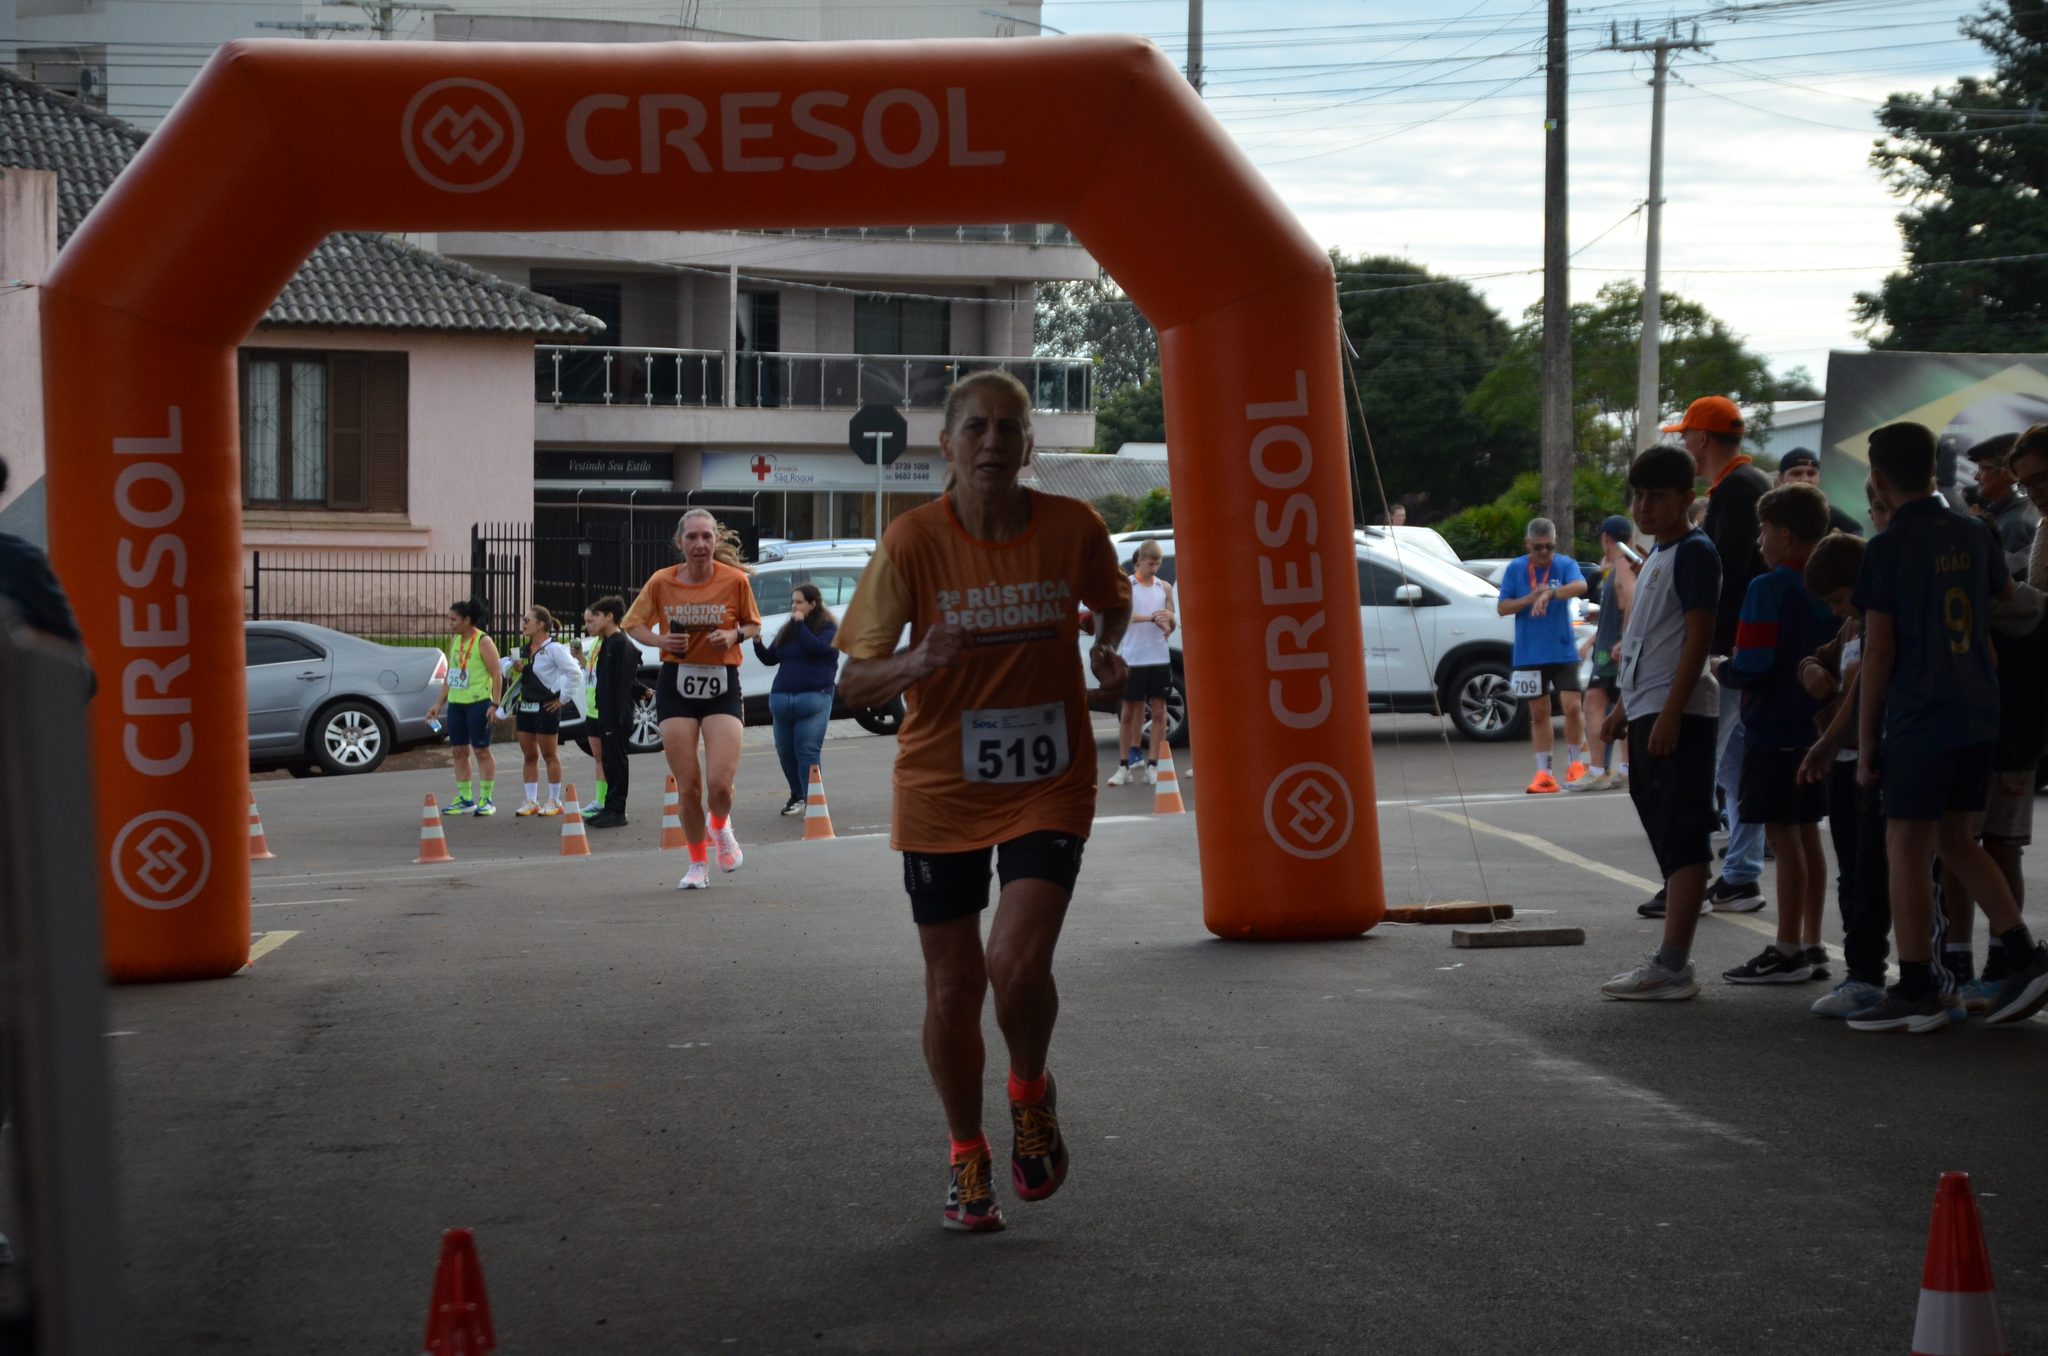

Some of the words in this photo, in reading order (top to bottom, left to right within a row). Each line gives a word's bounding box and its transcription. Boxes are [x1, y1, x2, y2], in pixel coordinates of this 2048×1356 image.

[565, 87, 1006, 175] CRESOL
[569, 459, 606, 472] Vestindo
[608, 459, 624, 471] Seu
[626, 459, 652, 471] Estilo
[790, 473, 815, 483] Roque
[1246, 368, 1333, 730] CRESOL
[1936, 546, 1971, 573] JOÃO
[112, 404, 194, 777] CRESOL
[967, 579, 1072, 609] RÚSTICA
[676, 602, 727, 615] RÚSTICA
[1944, 586, 1973, 654] 9
[683, 675, 721, 696] 679
[1515, 680, 1537, 694] 709
[978, 735, 1057, 779] 519
